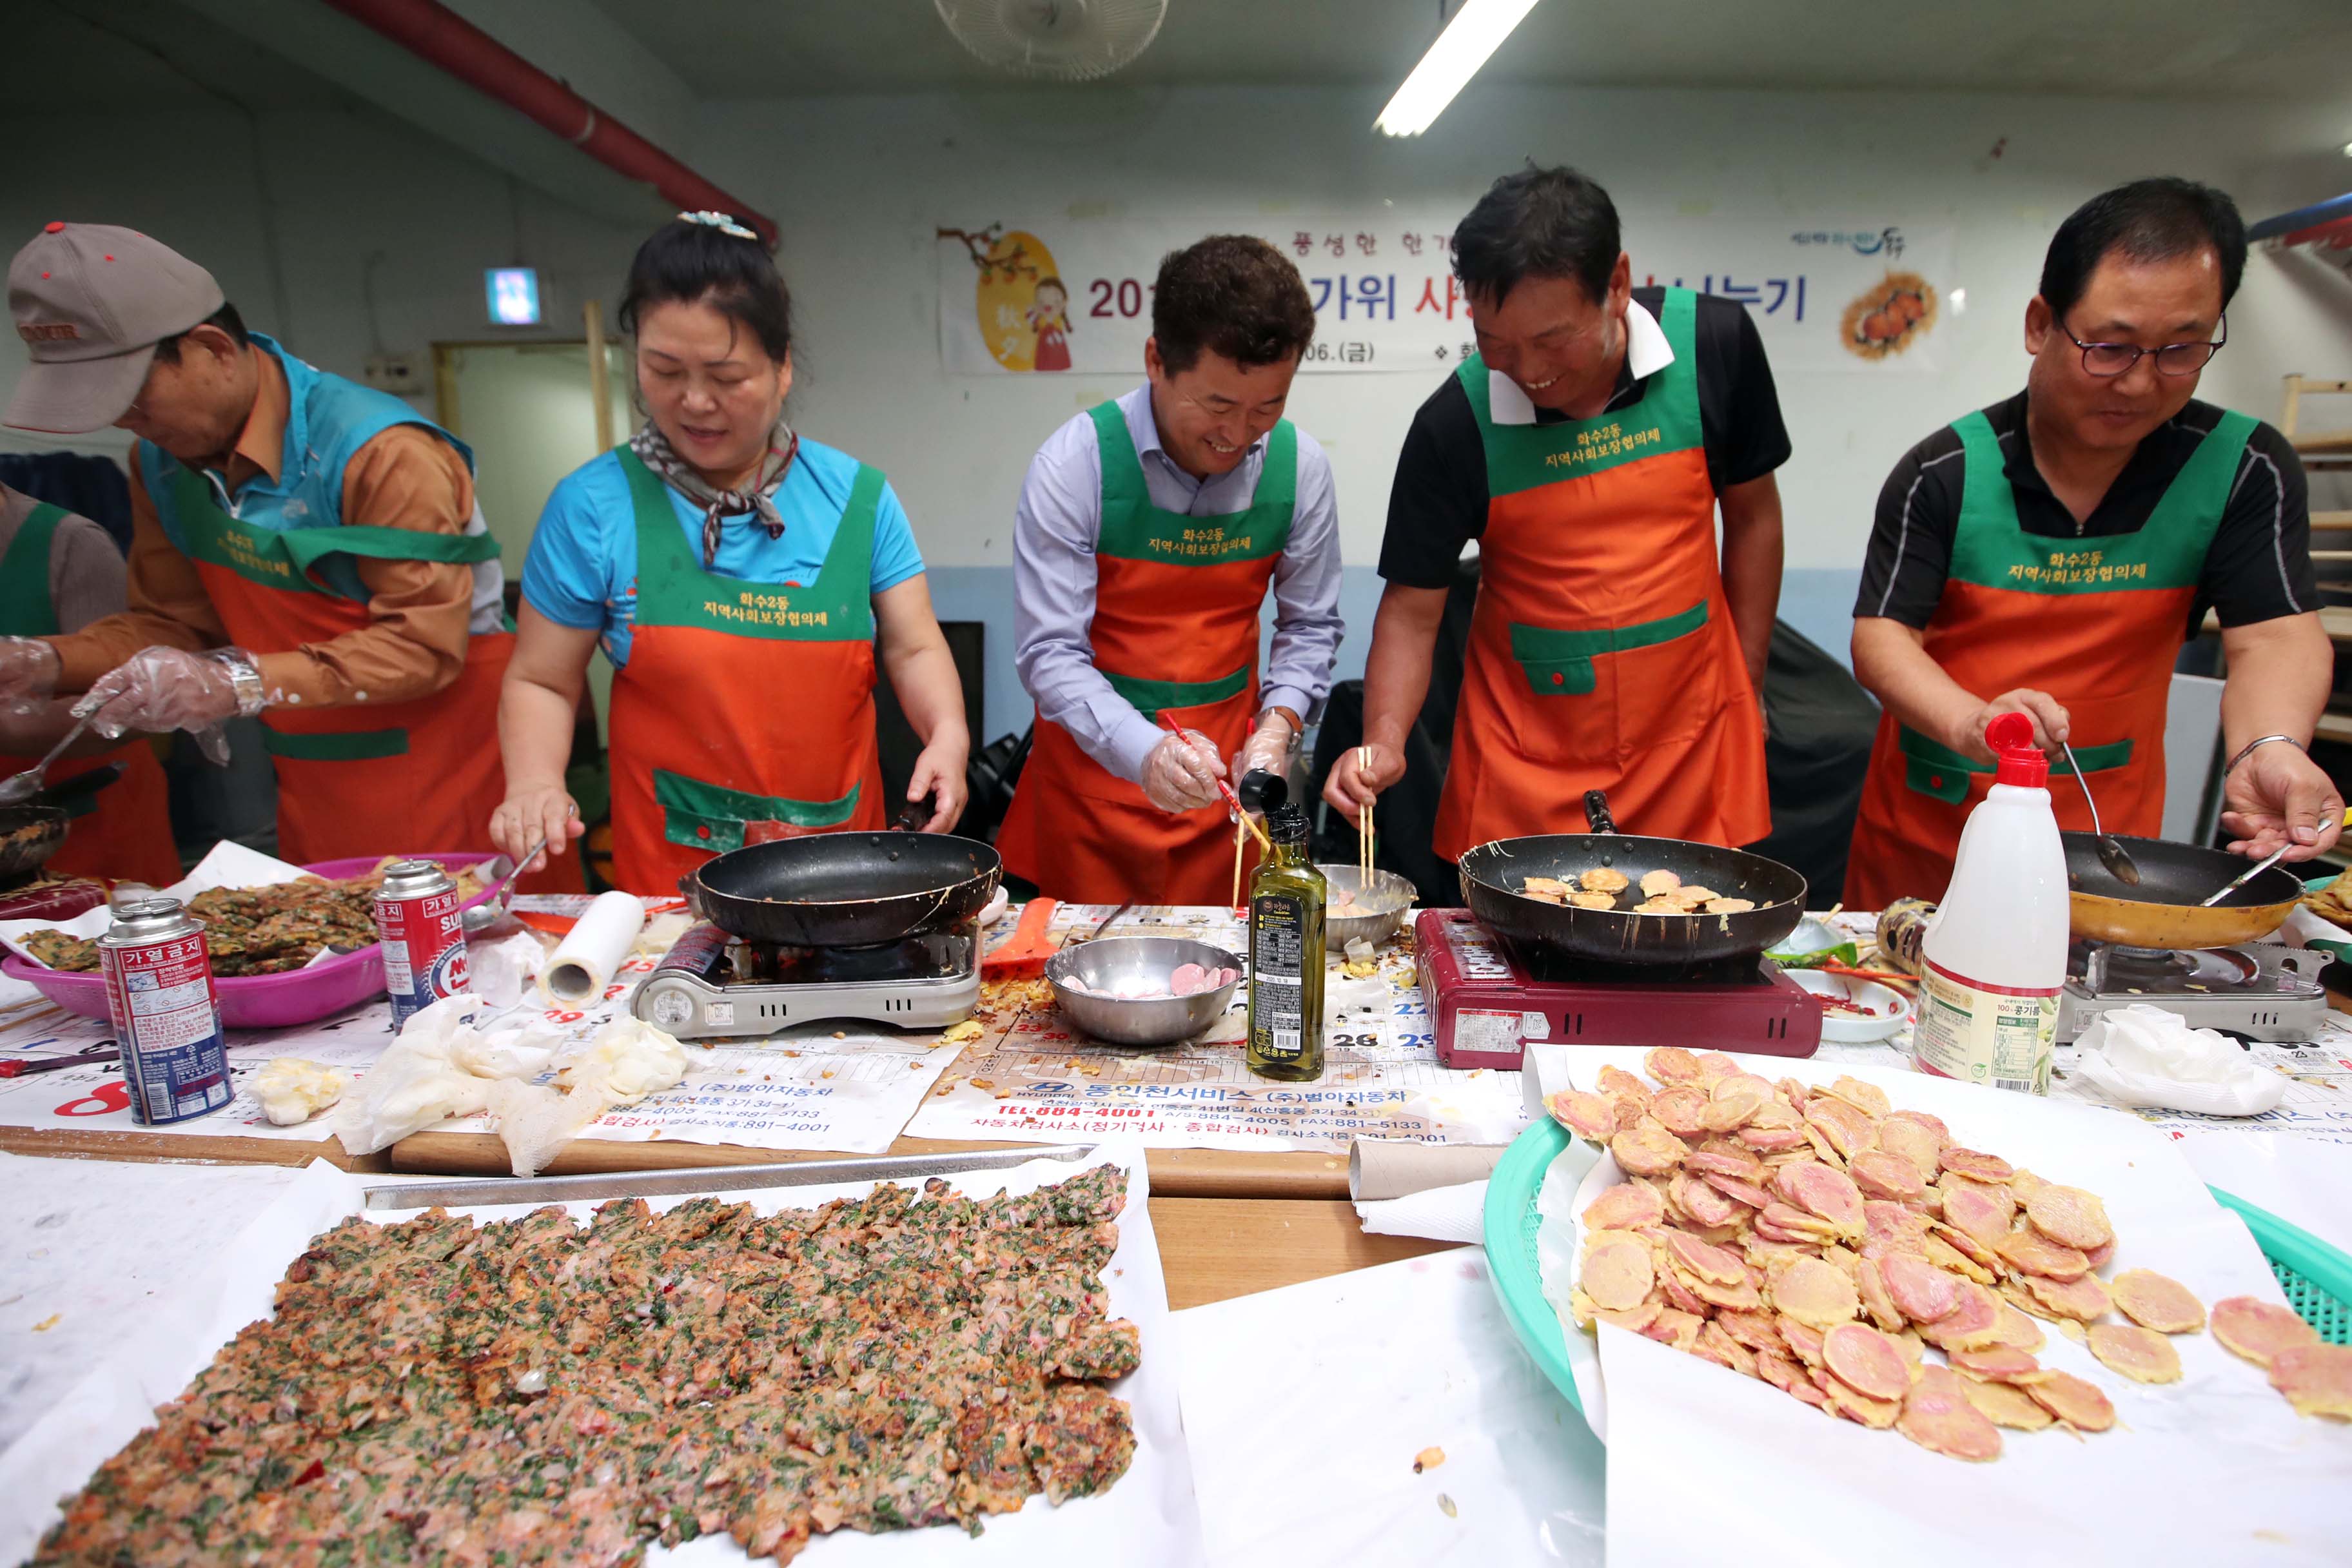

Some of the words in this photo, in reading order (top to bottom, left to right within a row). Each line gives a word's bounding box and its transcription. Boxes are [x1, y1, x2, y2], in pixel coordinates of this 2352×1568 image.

[1292, 231, 1377, 257] 풍성한
[1090, 278, 1156, 318] 20
[1414, 273, 1474, 321] 사
[1577, 423, 1623, 446] 화수2동
[1545, 427, 1661, 468] 지역사회보장협의체
[1182, 527, 1225, 543] 화수2동
[2050, 551, 2104, 568] 화수2동
[2008, 562, 2147, 585] 지역사회보장협의체
[739, 592, 790, 612] 화수2동
[703, 601, 828, 627] 지역사회보장협의체
[125, 939, 199, 965] 가열금지
[2014, 1005, 2041, 1017] 콩기름
[1084, 1084, 1256, 1102] 동인천서비스
[1266, 1090, 1407, 1104] (주)범아자동차
[1300, 1117, 1422, 1129] FAX:881-5133
